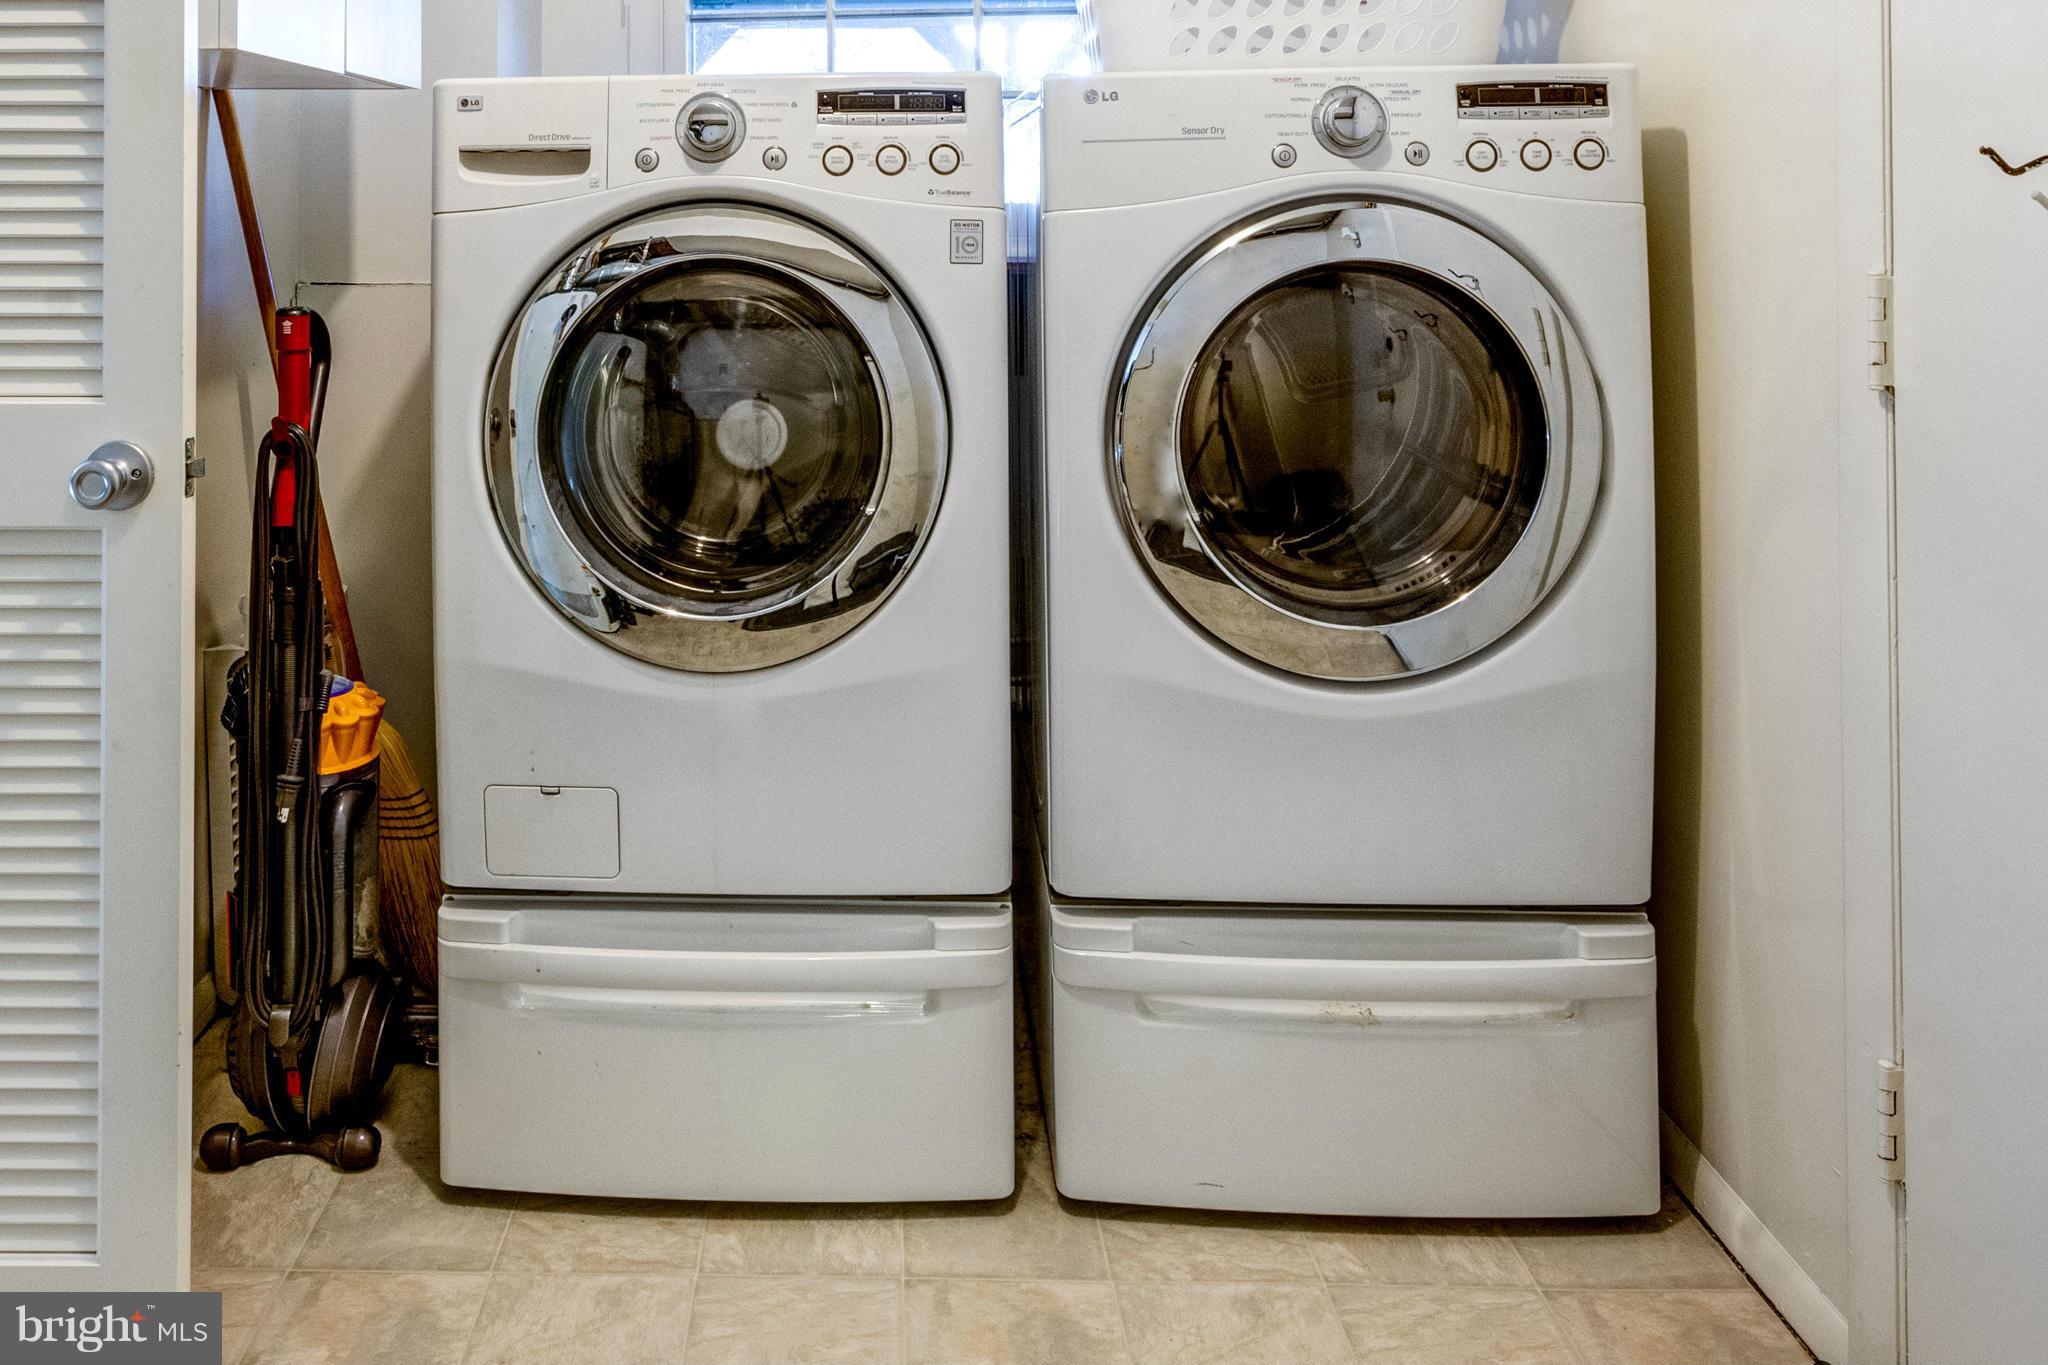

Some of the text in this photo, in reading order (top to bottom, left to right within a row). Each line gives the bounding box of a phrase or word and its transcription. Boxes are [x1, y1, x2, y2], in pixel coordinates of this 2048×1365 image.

[1102, 91, 1119, 101] LG
[1181, 126, 1225, 136] Sensor Dry
[528, 132, 551, 142] Direct
[551, 132, 571, 142] Drive
[935, 188, 971, 196] TrueBalance
